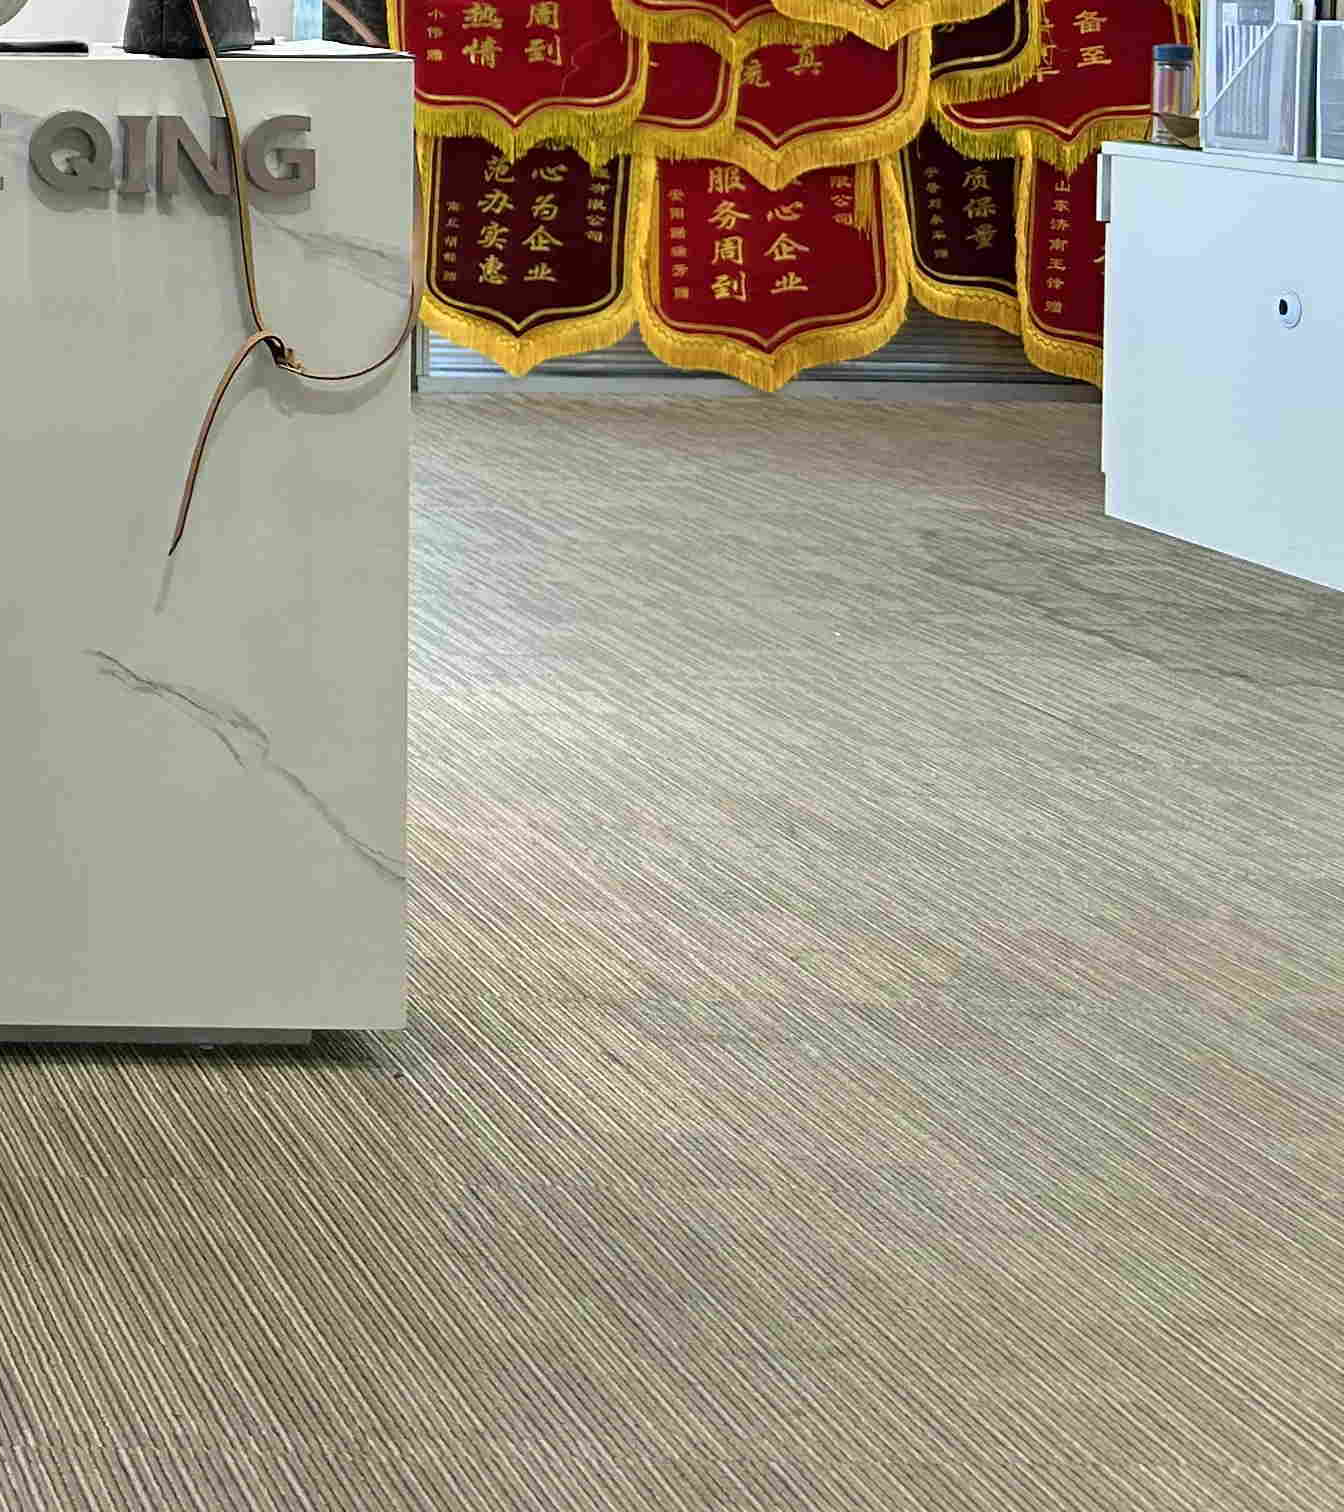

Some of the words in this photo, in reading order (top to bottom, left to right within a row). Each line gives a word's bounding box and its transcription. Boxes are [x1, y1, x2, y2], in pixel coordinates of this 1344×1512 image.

[29, 110, 317, 194] QING
[708, 167, 751, 303] 服务周到
